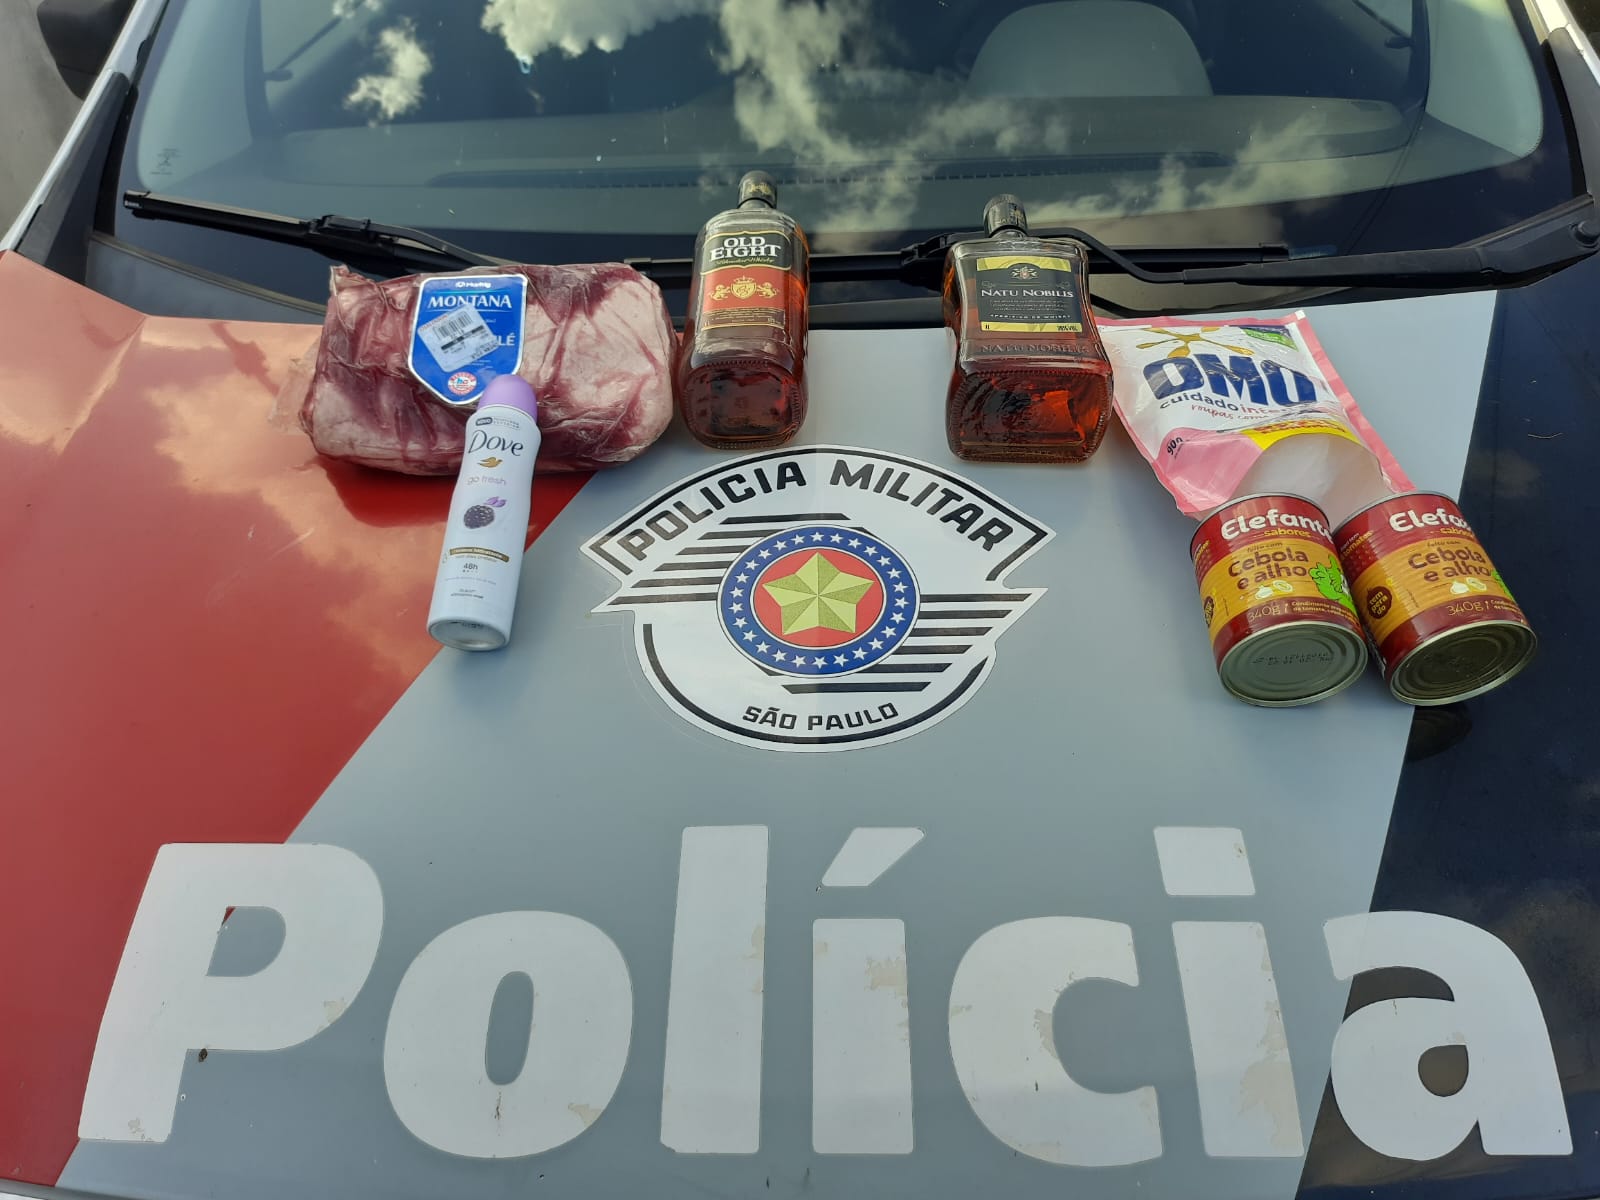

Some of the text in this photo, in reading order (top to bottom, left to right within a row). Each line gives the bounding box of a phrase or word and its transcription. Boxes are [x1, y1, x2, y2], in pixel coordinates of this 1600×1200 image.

[724, 236, 766, 248] OLD
[710, 244, 782, 261] EIGHT
[427, 294, 513, 309] MONTANA
[981, 289, 1074, 298] NATU NOBILIS
[498, 332, 516, 346] LÉ
[1143, 353, 1318, 407] OMO
[1160, 392, 1239, 412] cuidado
[1191, 404, 1234, 420] roupas
[468, 429, 524, 456] Dove
[467, 475, 507, 486] go fresh
[617, 459, 1014, 561] POLICIA MILITAR
[1263, 528, 1312, 538] sabores
[463, 562, 479, 570] 48h
[1228, 547, 1309, 577] Cebola
[1408, 546, 1486, 569] Cebola
[1237, 562, 1308, 590] e alho
[1423, 560, 1492, 582] e alho
[1247, 604, 1281, 622] 340g
[1446, 601, 1484, 616] 340g
[742, 702, 899, 731] SÃO PAULO
[78, 825, 1573, 1166] Polícia
